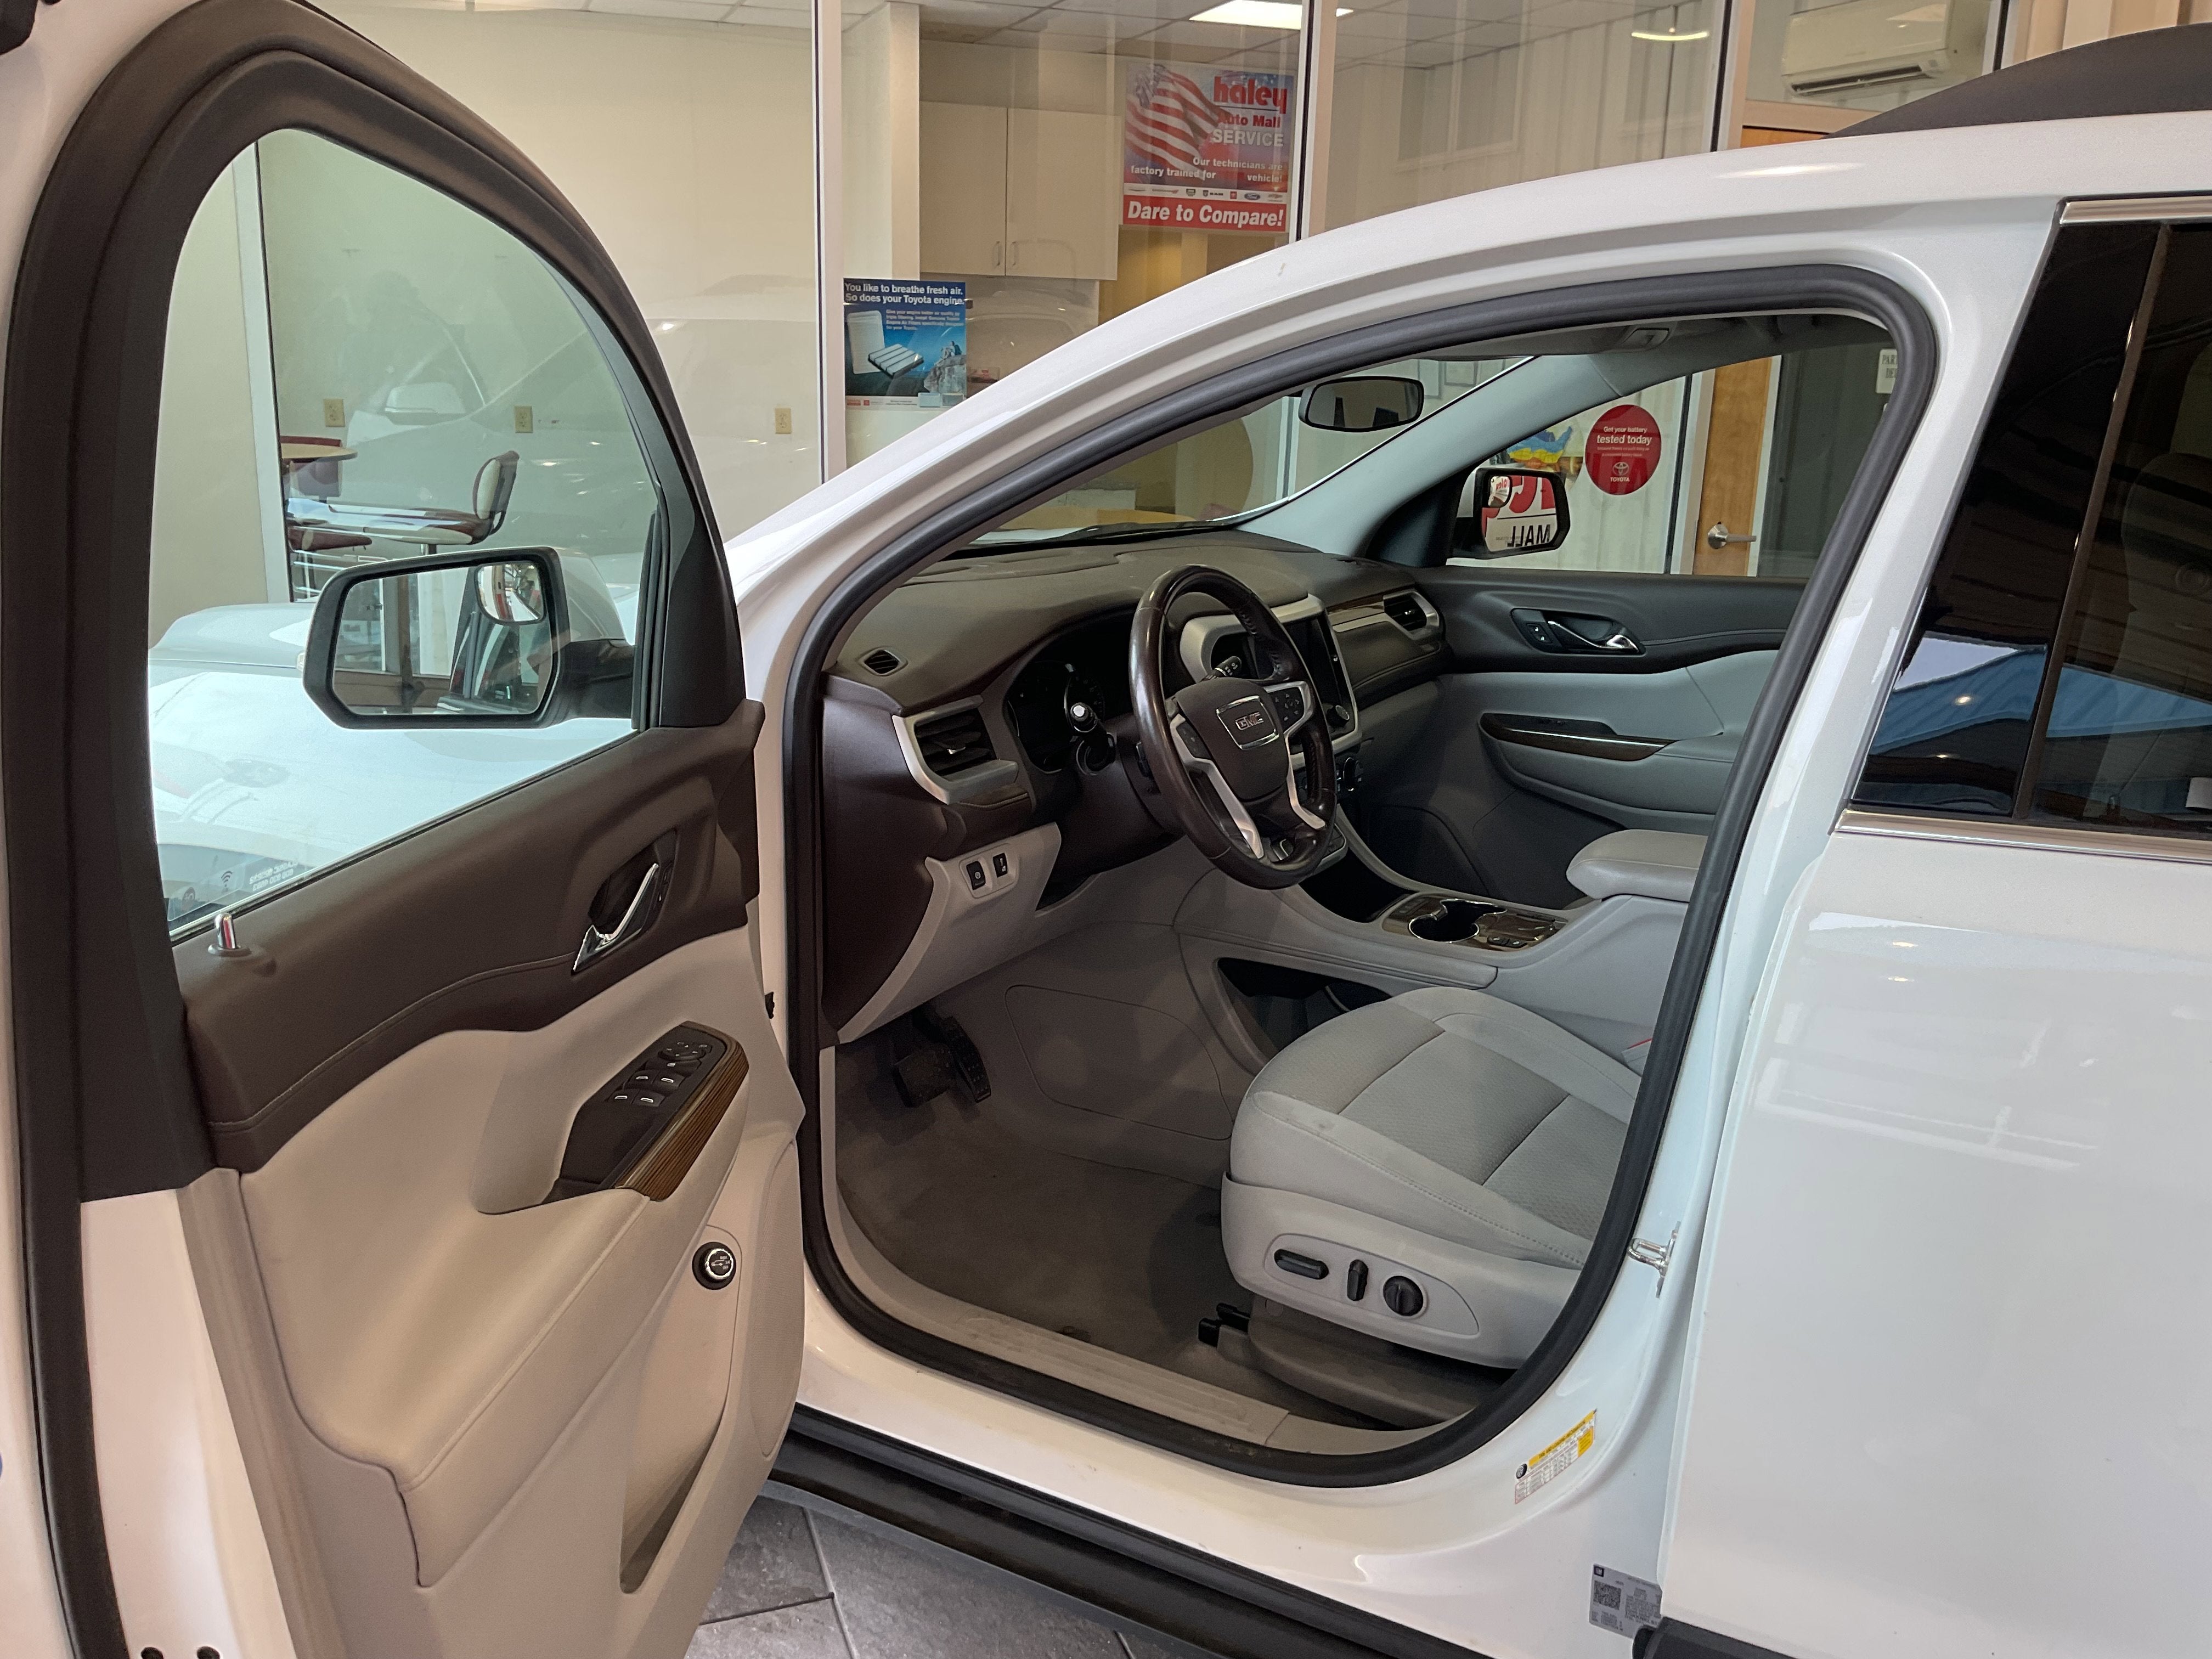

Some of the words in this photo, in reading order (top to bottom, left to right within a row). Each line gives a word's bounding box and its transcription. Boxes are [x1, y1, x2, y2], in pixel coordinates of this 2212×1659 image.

[1213, 76, 1288, 114] haley
[1217, 112, 1248, 127] Auto
[1252, 115, 1280, 128] Mall
[1211, 128, 1284, 146] SERVICE
[1193, 156, 1210, 166] Our
[1213, 159, 1265, 170] technicians
[1131, 165, 1164, 177] factory
[1166, 167, 1200, 178] trained
[1202, 171, 1216, 179] for
[1247, 173, 1283, 183] vehicle!
[1127, 201, 1171, 220] Dare
[1176, 204, 1194, 222] to
[1199, 205, 1284, 228] Compare!
[845, 283, 861, 291] You
[863, 283, 879, 292] like
[881, 284, 890, 292] to
[891, 284, 925, 294] breathe
[927, 285, 948, 295] fresh
[950, 286, 963, 295] air.
[845, 293, 857, 301] So
[859, 294, 881, 302] does
[882, 296, 902, 304] your
[903, 295, 932, 305] Toyota
[933, 296, 964, 306] engine.
[1596, 435, 1626, 444] tested
[1627, 435, 1652, 445] today
[1235, 712, 1264, 730] GMC
